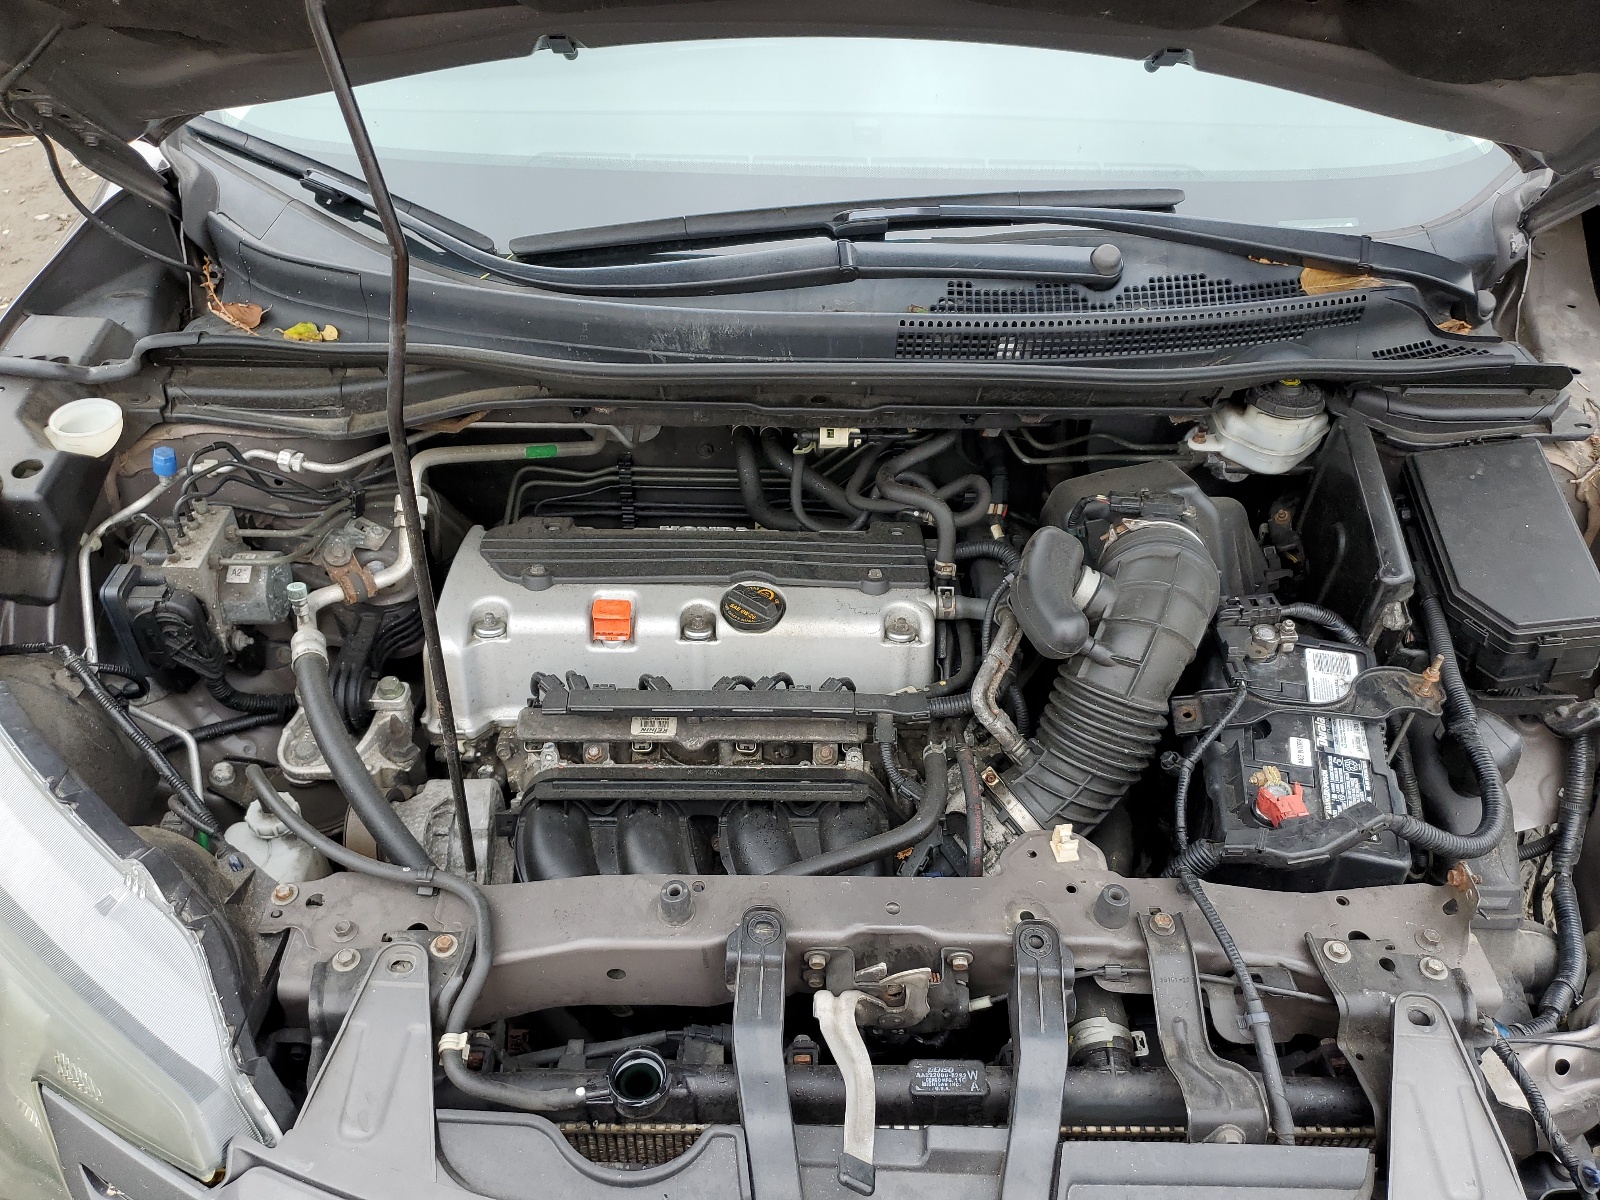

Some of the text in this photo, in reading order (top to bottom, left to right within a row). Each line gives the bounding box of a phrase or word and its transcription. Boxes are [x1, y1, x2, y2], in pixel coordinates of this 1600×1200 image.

[231, 568, 242, 576] A2
[1315, 717, 1328, 747] Durala
[967, 1069, 978, 1081] W
